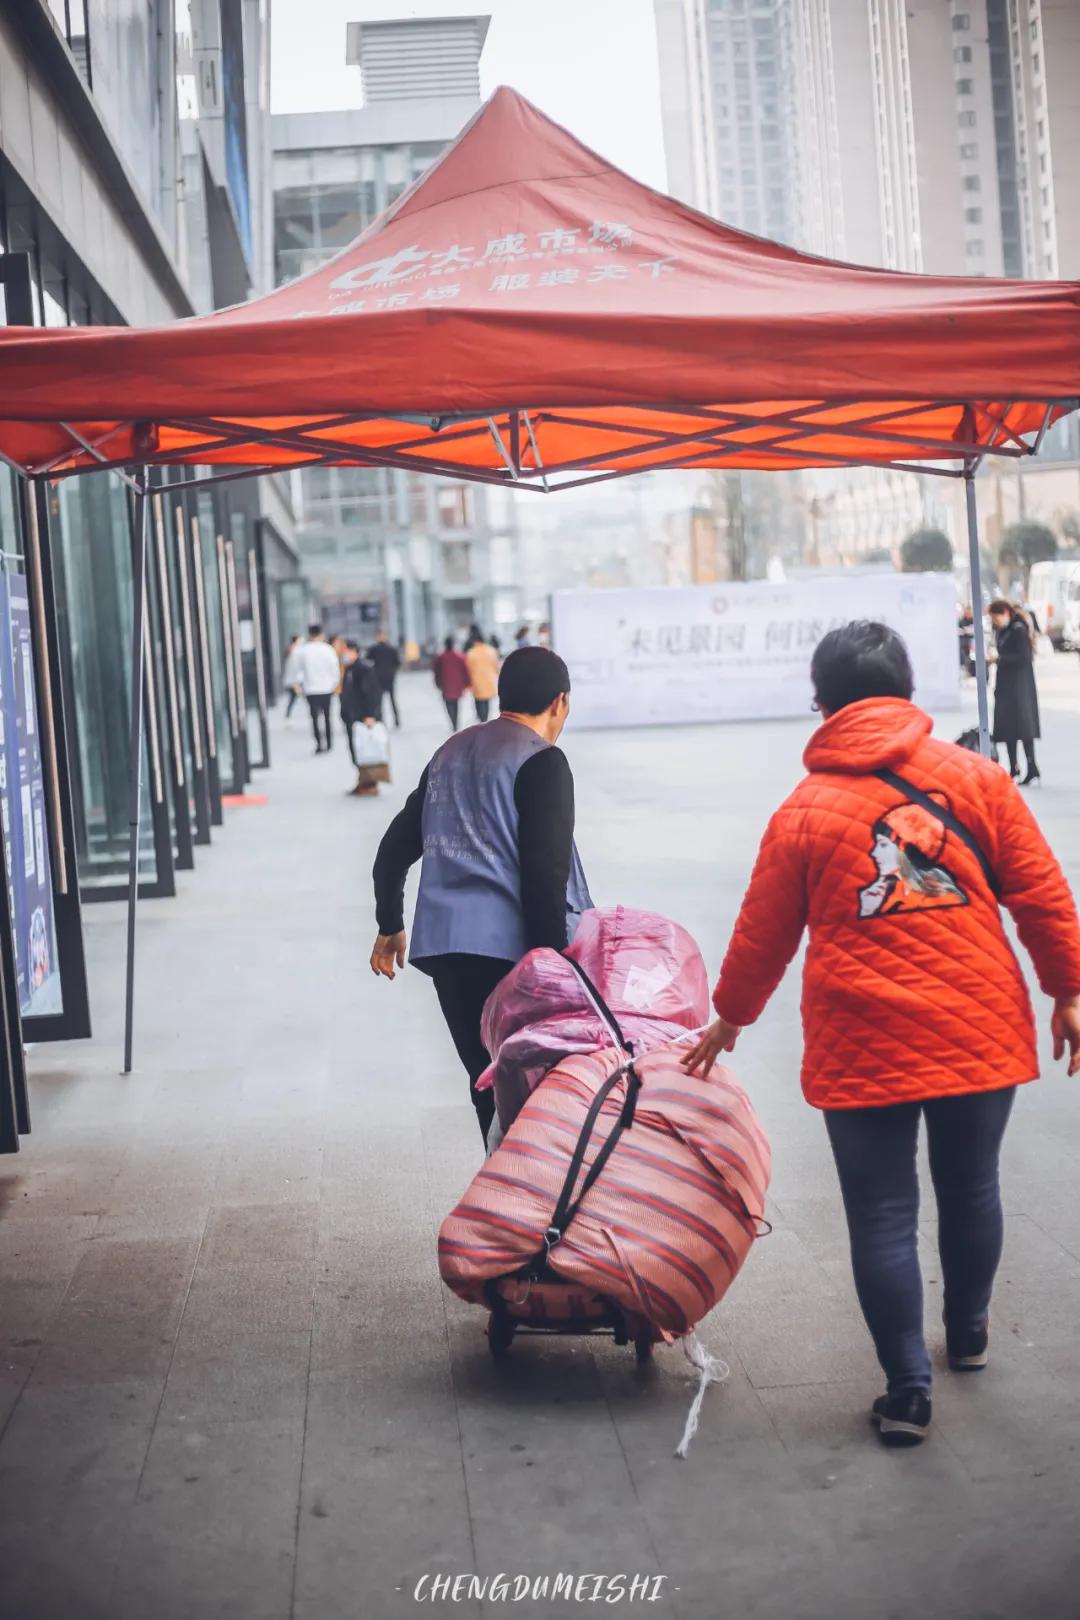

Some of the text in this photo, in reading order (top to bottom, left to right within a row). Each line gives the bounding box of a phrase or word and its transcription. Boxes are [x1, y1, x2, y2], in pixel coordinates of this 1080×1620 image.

[431, 220, 634, 268] 大成市场
[488, 255, 679, 291] 服装天下
